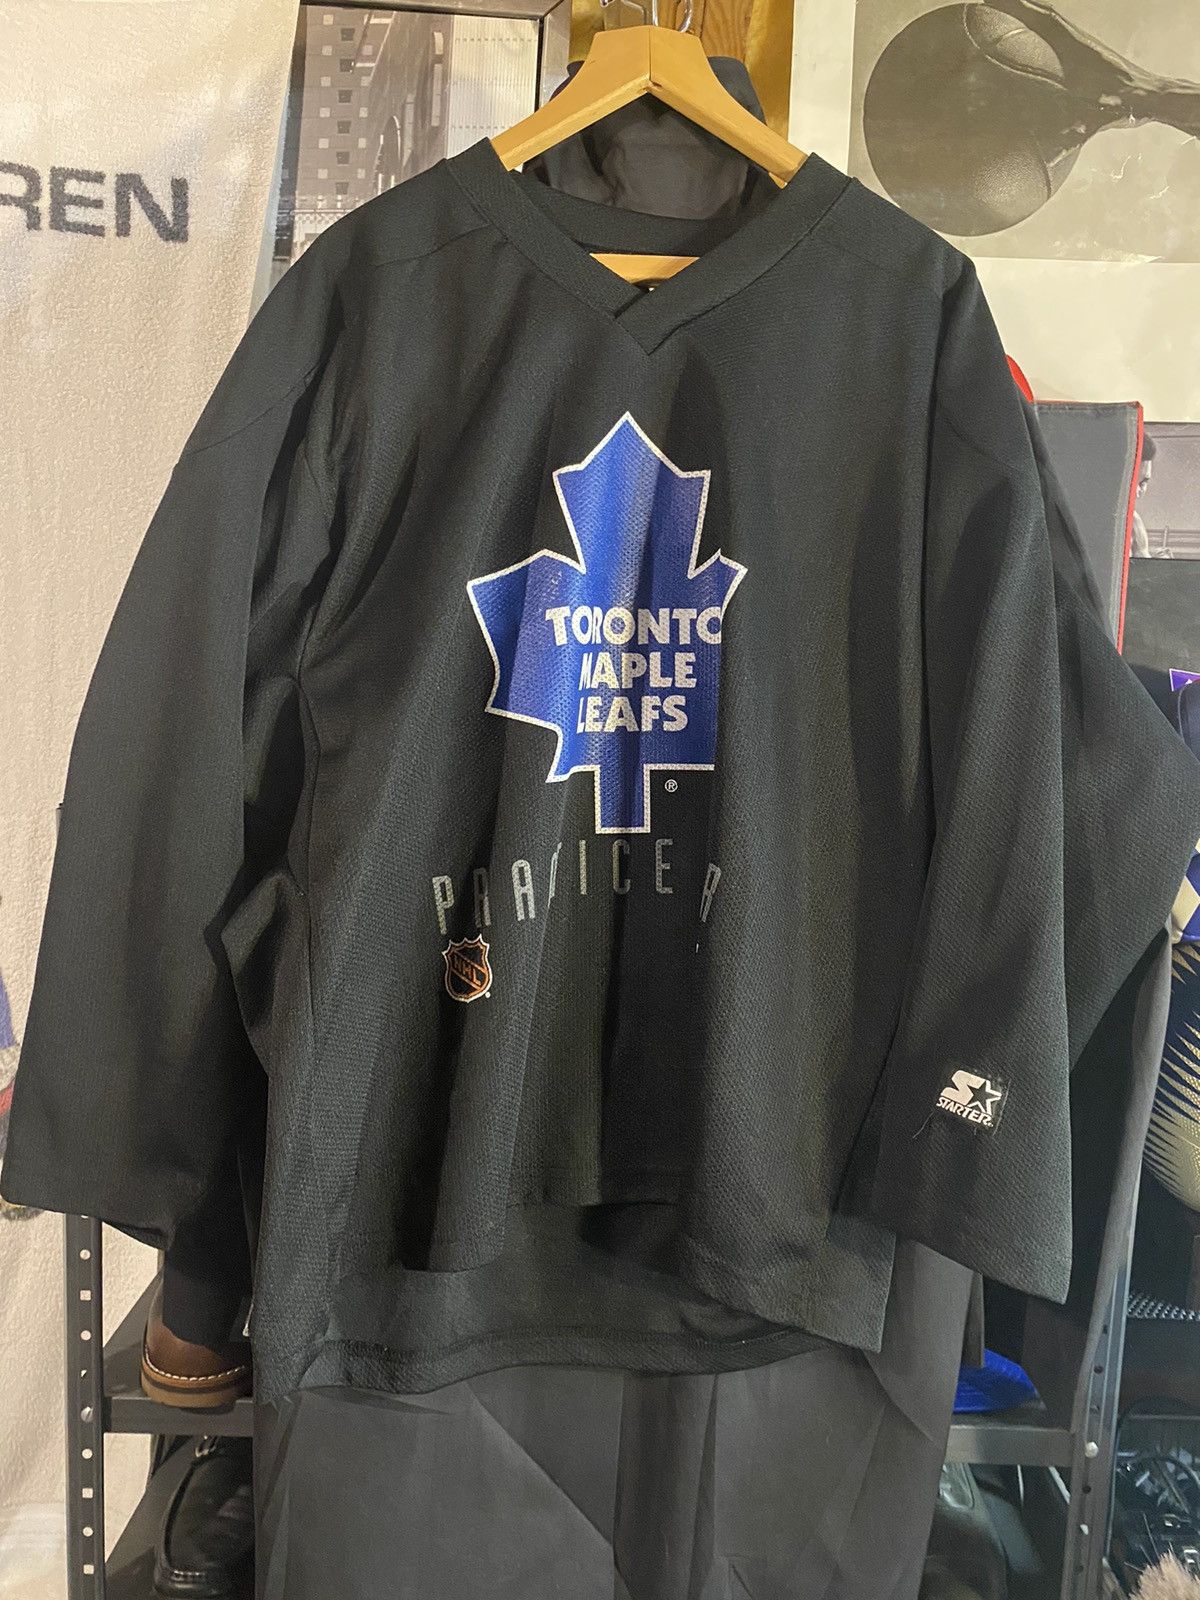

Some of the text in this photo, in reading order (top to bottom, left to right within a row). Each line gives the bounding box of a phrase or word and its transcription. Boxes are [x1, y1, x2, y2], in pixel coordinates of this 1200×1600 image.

[545, 605, 722, 646] TORONTO
[578, 651, 697, 690] MAPLE
[576, 695, 688, 733] LEAFS
[936, 1096, 991, 1126] STARTER
